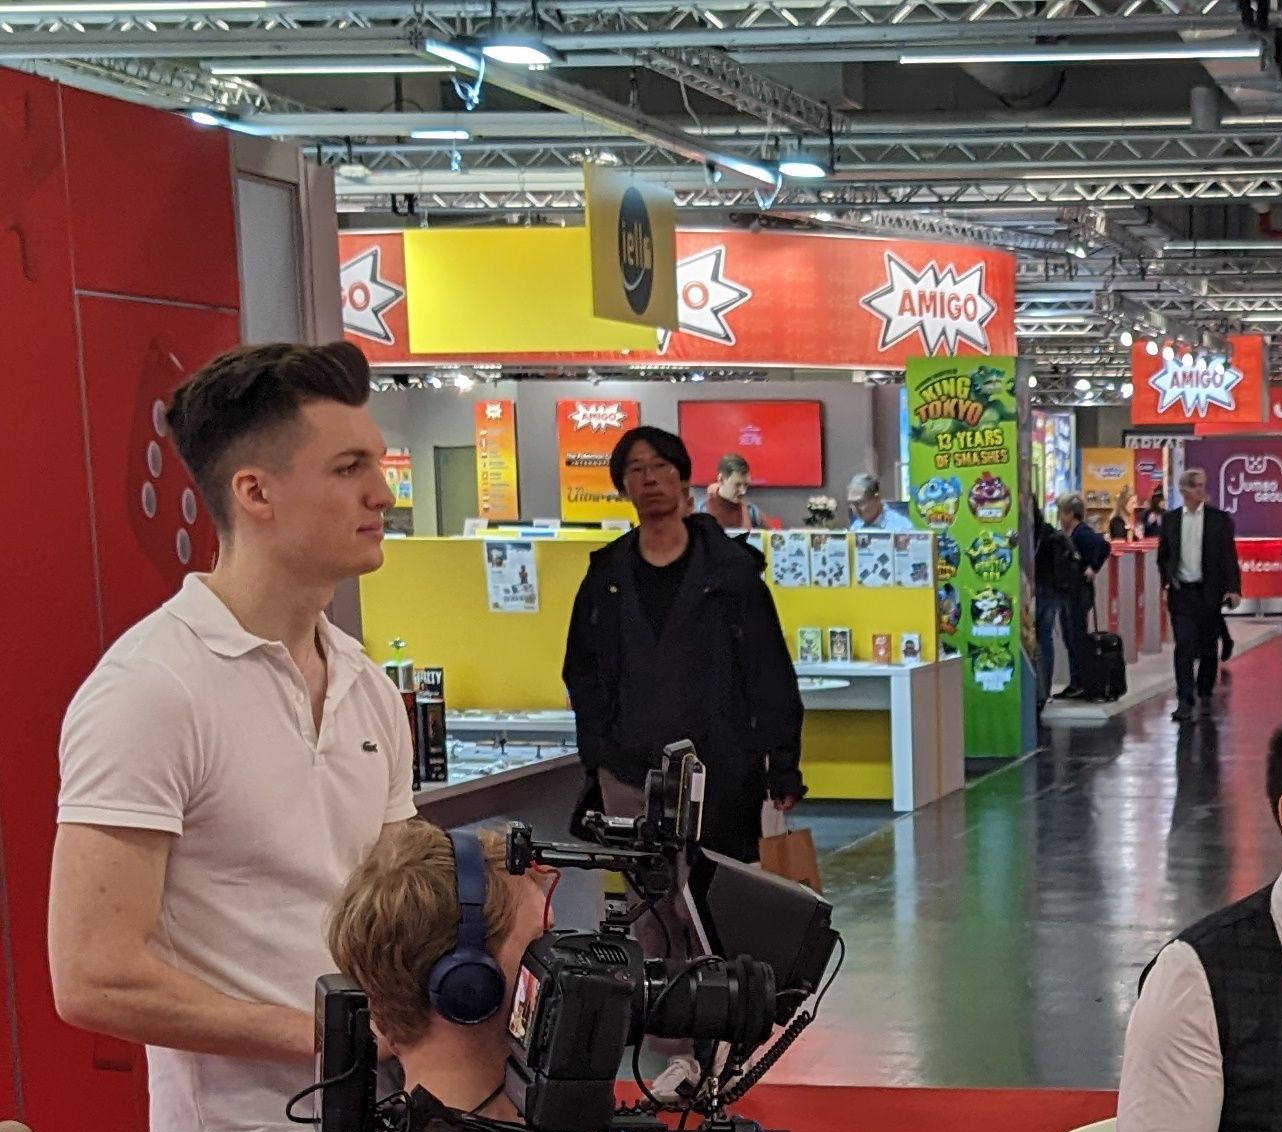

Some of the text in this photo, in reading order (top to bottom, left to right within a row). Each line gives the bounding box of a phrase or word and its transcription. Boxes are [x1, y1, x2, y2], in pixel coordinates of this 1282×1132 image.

[899, 288, 978, 321] AMIGO
[1169, 370, 1223, 389] AMIGO
[915, 398, 983, 427] TOKYO
[956, 428, 1004, 449] YEARS
